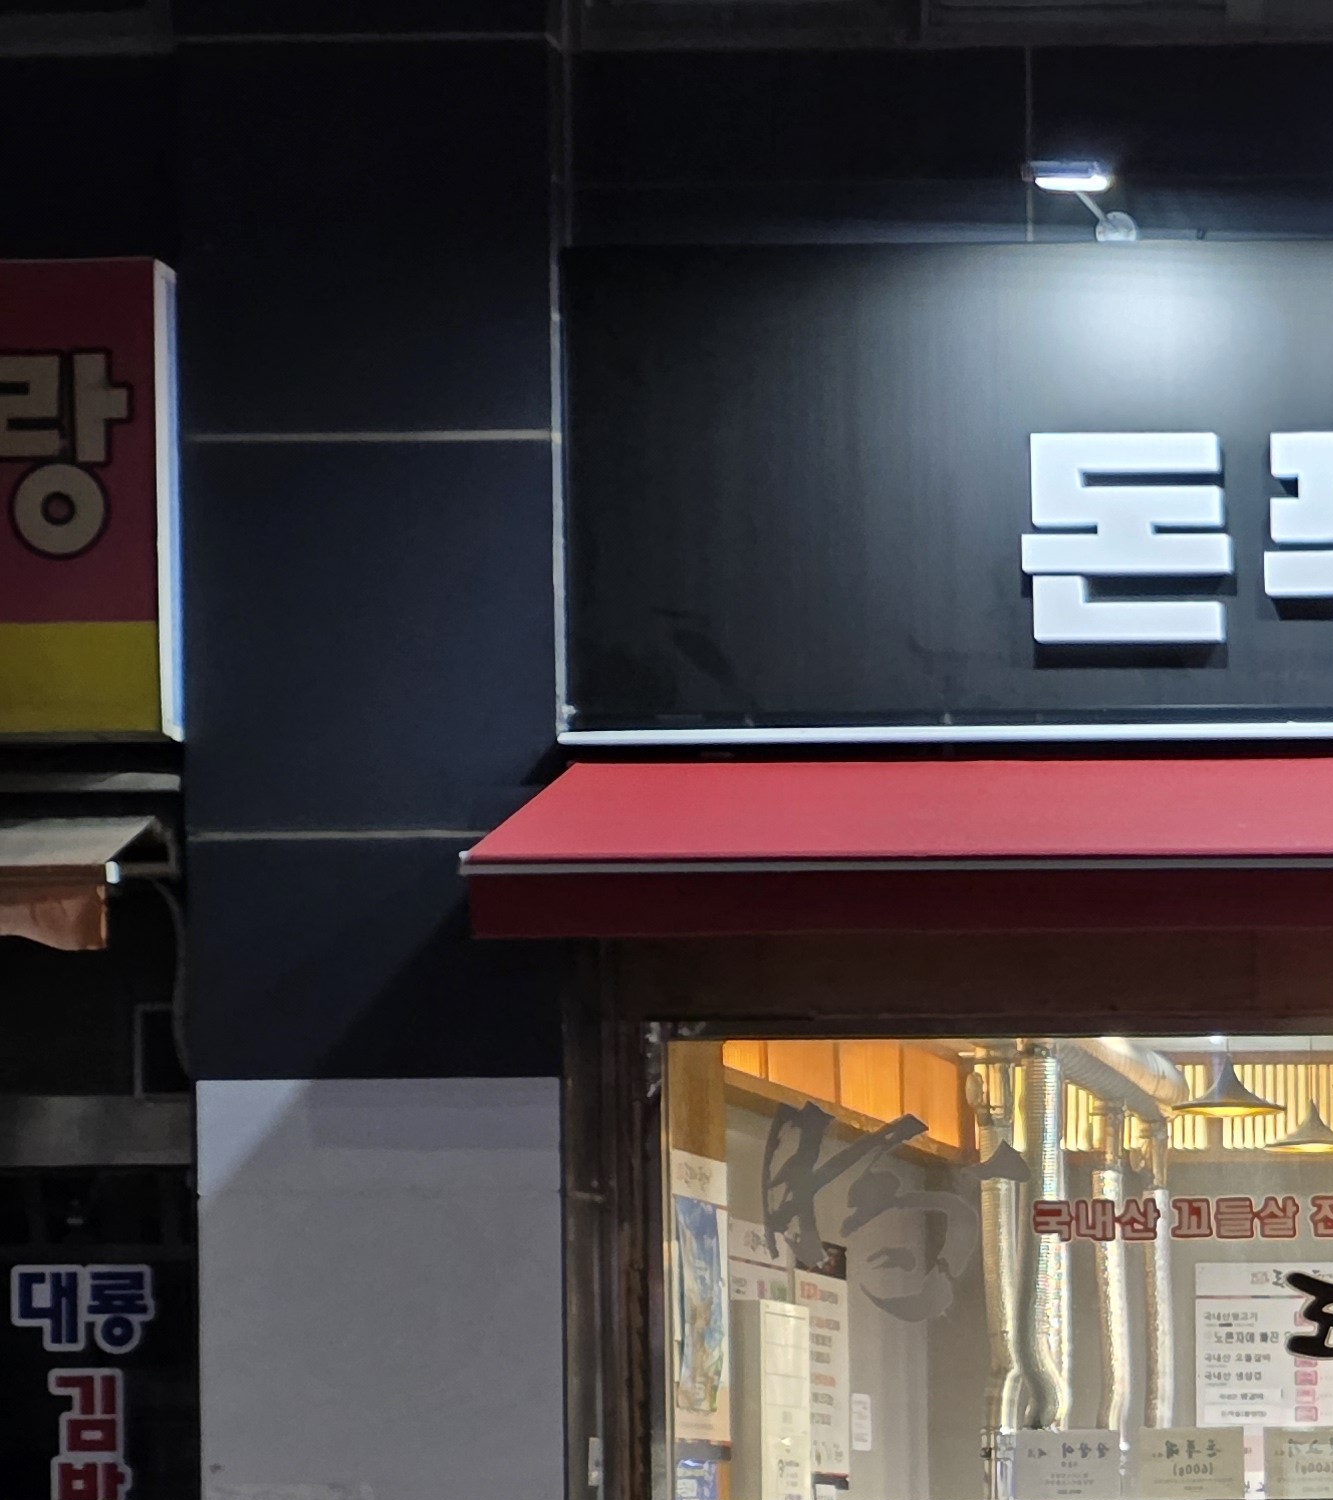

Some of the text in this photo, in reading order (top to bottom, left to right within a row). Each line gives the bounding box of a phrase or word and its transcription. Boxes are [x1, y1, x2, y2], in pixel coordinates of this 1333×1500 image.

[1033, 1198, 1160, 1242] 국내산
[1170, 1195, 1299, 1240] 꼬들살
[11, 1263, 155, 1354] 대룡
